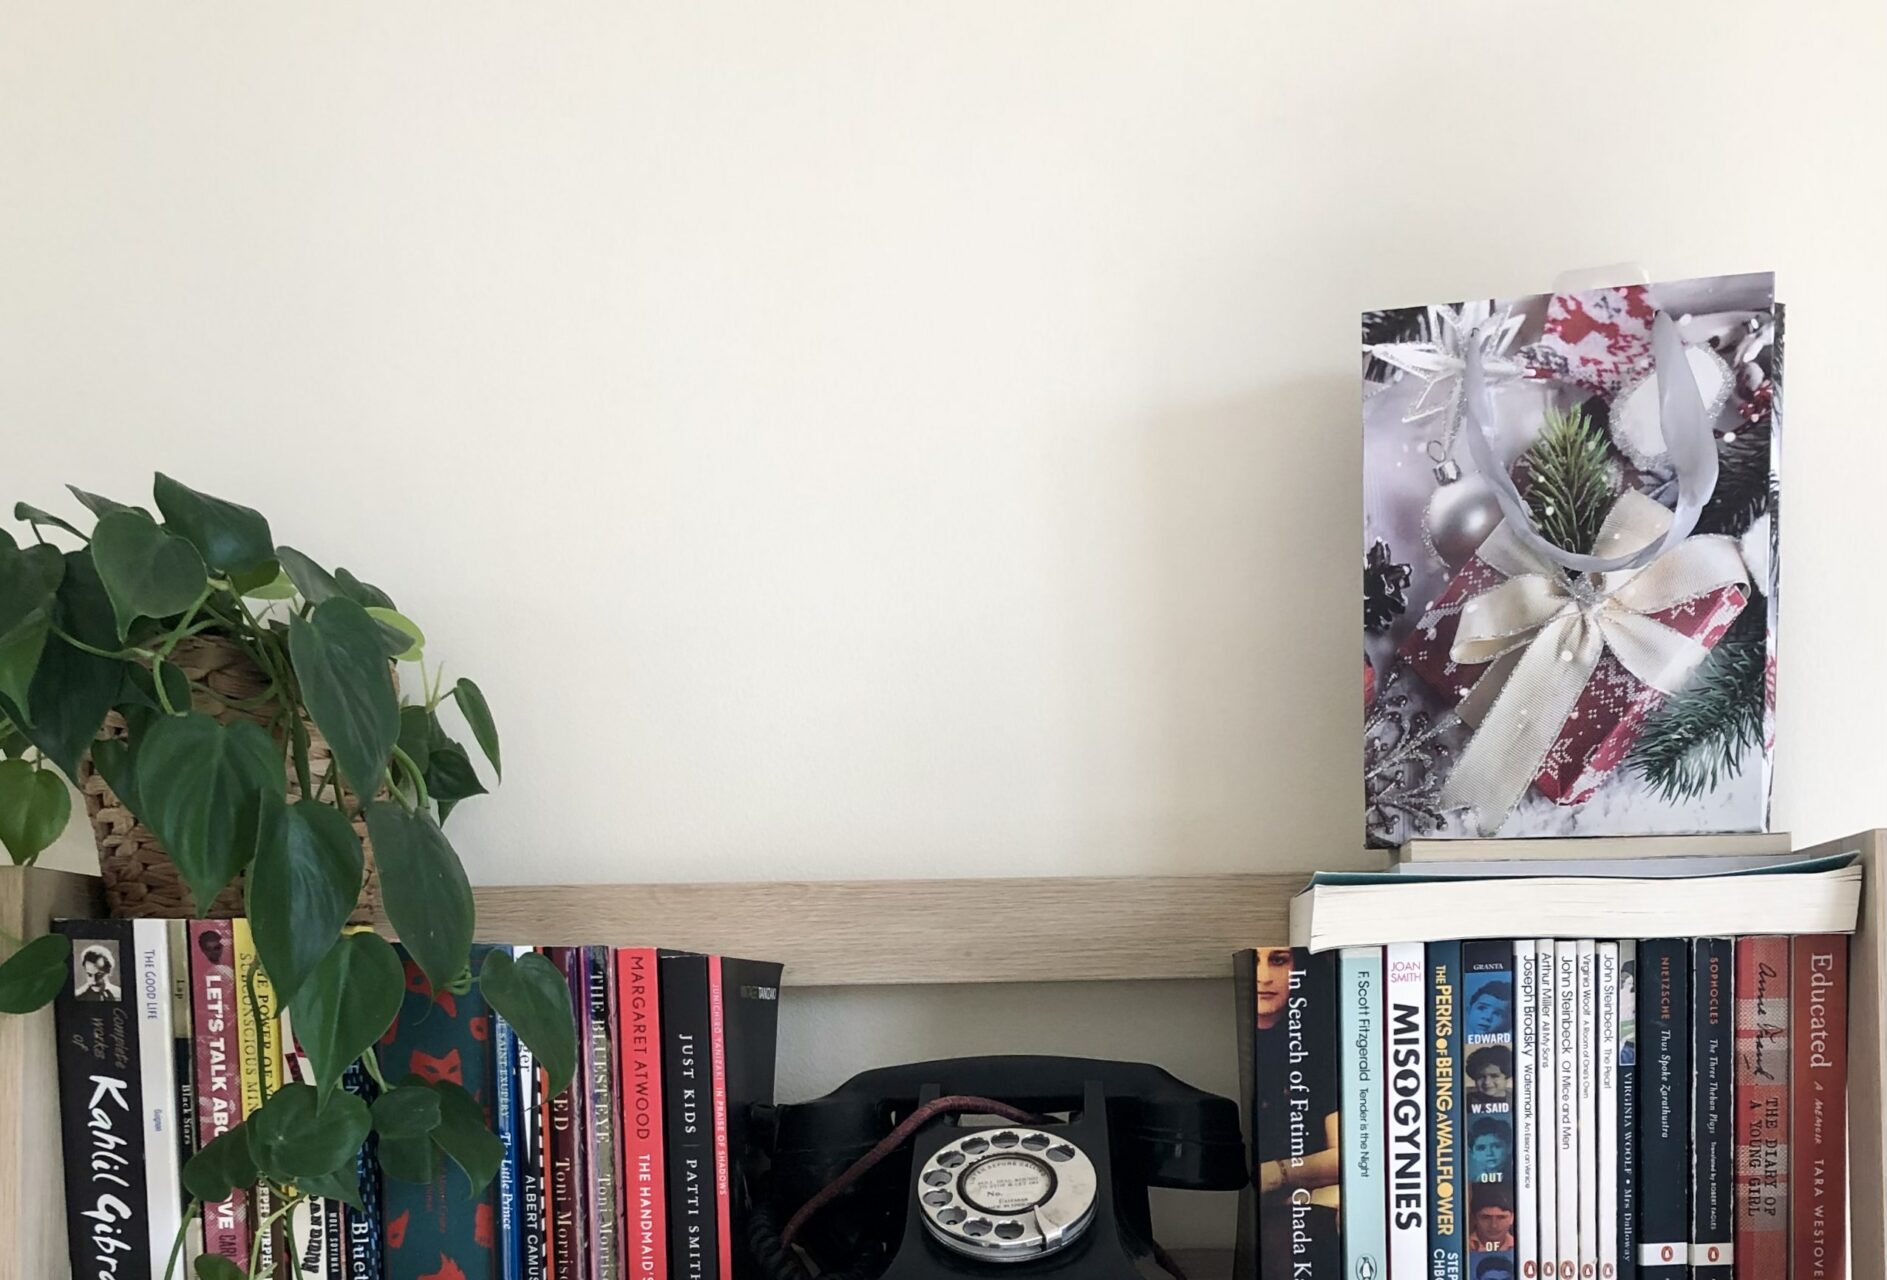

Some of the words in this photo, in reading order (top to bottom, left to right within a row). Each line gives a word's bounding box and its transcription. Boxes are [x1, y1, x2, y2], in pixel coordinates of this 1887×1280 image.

[144, 949, 156, 968] THE
[1288, 970, 1306, 989] In
[1391, 961, 1421, 972] JOAN
[1521, 956, 1535, 1003] Joseph
[1561, 956, 1572, 987] John
[1581, 955, 1591, 987] Virginia
[145, 971, 156, 1002] GOOD
[206, 975, 224, 1033] LET'S
[590, 971, 604, 1012] THE
[631, 956, 647, 1055] MARGARET
[1358, 980, 1369, 1015] Scott
[1661, 957, 1670, 1019] NIETZSCHE
[1709, 957, 1719, 1024] SOPHOCLES
[1289, 998, 1309, 1064] Search
[1435, 985, 1452, 1036] PERKS
[1521, 1006, 1535, 1056] Brodsky
[1562, 991, 1574, 1055] Steinbeck
[1604, 985, 1613, 1042] Steinbeck
[1811, 953, 1833, 1068] Educated
[592, 1019, 607, 1093] BLUEST
[679, 1034, 694, 1078] JUST
[1356, 1018, 1371, 1081] Fitzgerald
[1468, 1033, 1511, 1044] EDWARD
[209, 1037, 227, 1091] TALK
[1290, 1071, 1309, 1097] of
[1436, 1057, 1452, 1111] BEING
[1659, 1055, 1671, 1082] Spoke
[634, 1060, 650, 1140] ATWOOD
[684, 1089, 696, 1134] KIDS
[1359, 1088, 1369, 1122] Tender
[1524, 1064, 1533, 1118] Watermark
[1623, 1073, 1632, 1128] VIRGINIA
[1660, 1085, 1671, 1138] Zarathustra
[1709, 1080, 1718, 1110] Theban
[1765, 1098, 1778, 1128] THE
[88, 1074, 130, 1187] Kahlil
[595, 1105, 609, 1143] EYE
[715, 1101, 724, 1131] PRAISE
[1290, 1099, 1309, 1167] Fatima
[1393, 1003, 1422, 1230] MISOGYNIES
[1814, 1099, 1824, 1144] MEMOIR
[1358, 1149, 1369, 1177] Night
[1624, 1131, 1632, 1174] WOOLF
[1749, 1118, 1762, 1168] YOUNG
[1764, 1138, 1778, 1189] DIARY
[555, 1157, 571, 1201] Toni
[639, 1154, 650, 1181] THE
[686, 1159, 699, 1215] PATTI
[718, 1151, 727, 1195] SHADOWS
[1436, 1120, 1454, 1236] WALLFLOWER
[1813, 1159, 1824, 1197] TARA
[502, 1190, 513, 1229] Prince
[525, 1175, 537, 1227] ALBERT
[598, 1174, 611, 1216] Toni
[1748, 1177, 1760, 1216] GIRL
[1764, 1197, 1776, 1216] OF
[1292, 1188, 1312, 1253] Ghada
[1623, 1213, 1632, 1261] Dalloway
[330, 1238, 339, 1273] SOYINKA
